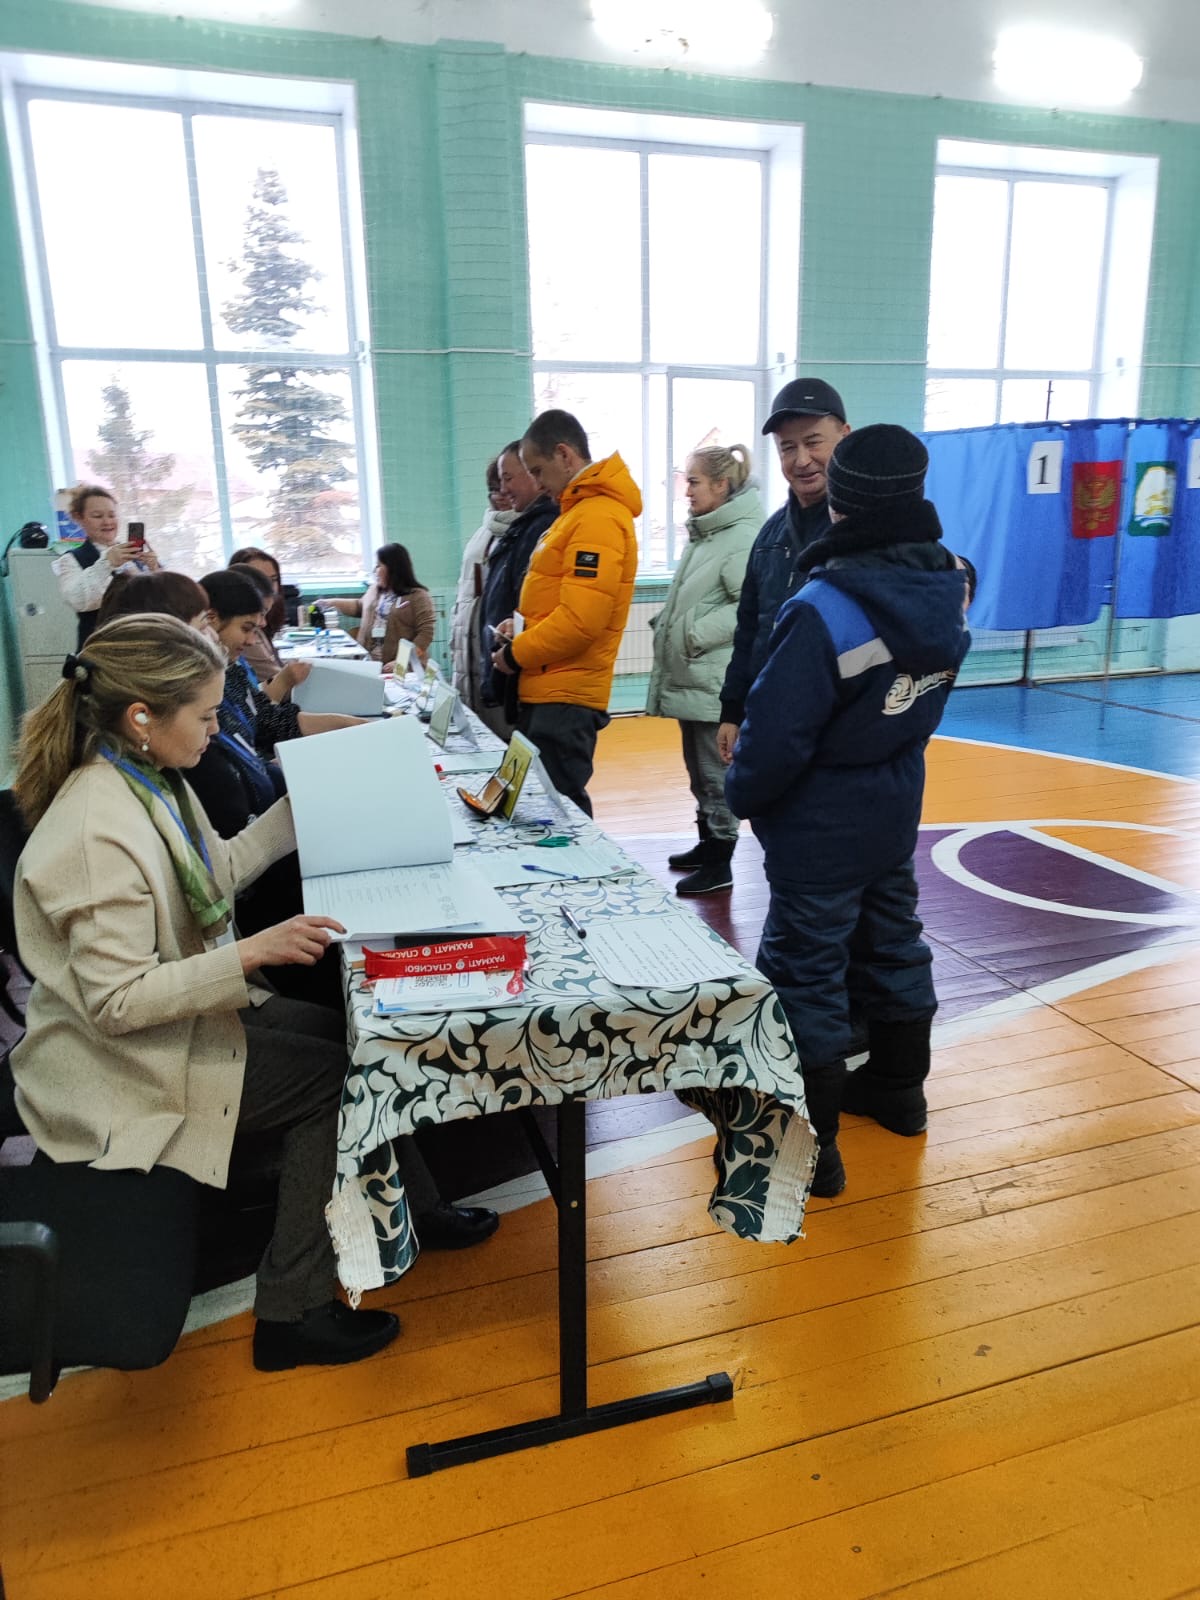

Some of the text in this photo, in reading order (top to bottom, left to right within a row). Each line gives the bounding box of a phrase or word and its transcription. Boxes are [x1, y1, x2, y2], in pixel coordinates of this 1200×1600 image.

[1035, 454, 1053, 485] 1
[435, 941, 474, 954] РАХМАТ!
[405, 963, 453, 973] СПАСИБО!
